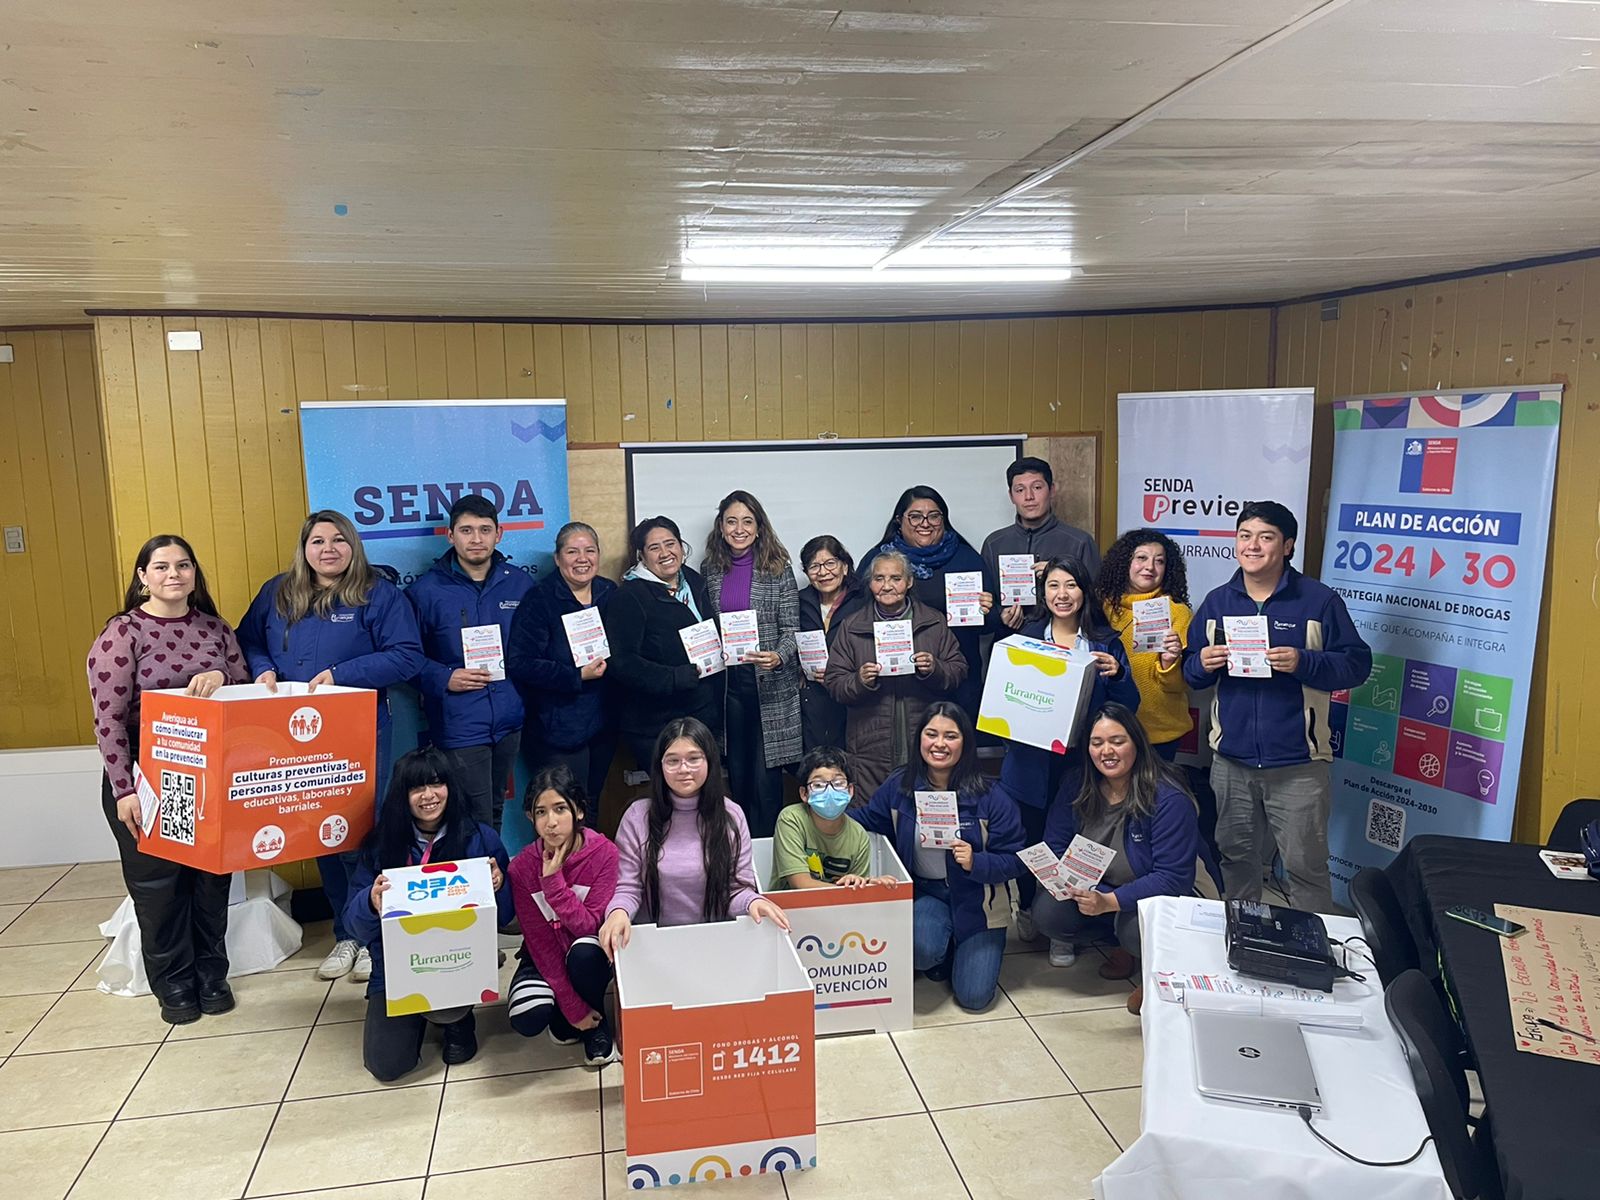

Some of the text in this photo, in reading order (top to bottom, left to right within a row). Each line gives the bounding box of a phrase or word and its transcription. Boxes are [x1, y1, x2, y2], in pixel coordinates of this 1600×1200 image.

[1144, 478, 1193, 492] SENDA
[354, 480, 543, 525] SENDA
[1355, 511, 1500, 536] PLAN DE ACCIÓN
[1334, 540, 1516, 588] 2024 30
[1385, 594, 1441, 612] NACIONAL
[1444, 602, 1460, 614] DE
[1462, 605, 1511, 621] DROGAS
[1354, 620, 1506, 653] CHILE QUE ACOMPAÑA E INTEGRA
[1004, 682, 1054, 706] Purranque
[162, 712, 186, 725] Averigua
[156, 724, 203, 740] cómo involucrar
[169, 740, 201, 752] comunidad
[156, 750, 204, 766] en la prevención
[270, 752, 334, 766] Promovemos
[235, 761, 360, 784] culturas preventivas en
[230, 772, 364, 800] personas y comunidades
[244, 786, 352, 809] educativas, laborales y
[1344, 778, 1438, 815] Plan de Acción 2024-2030
[1370, 776, 1412, 796] Descarga el
[278, 802, 322, 814] barriales.
[410, 950, 472, 966] Purranque
[769, 1034, 799, 1042] ALCOHOL
[733, 1042, 800, 1068] 1412
